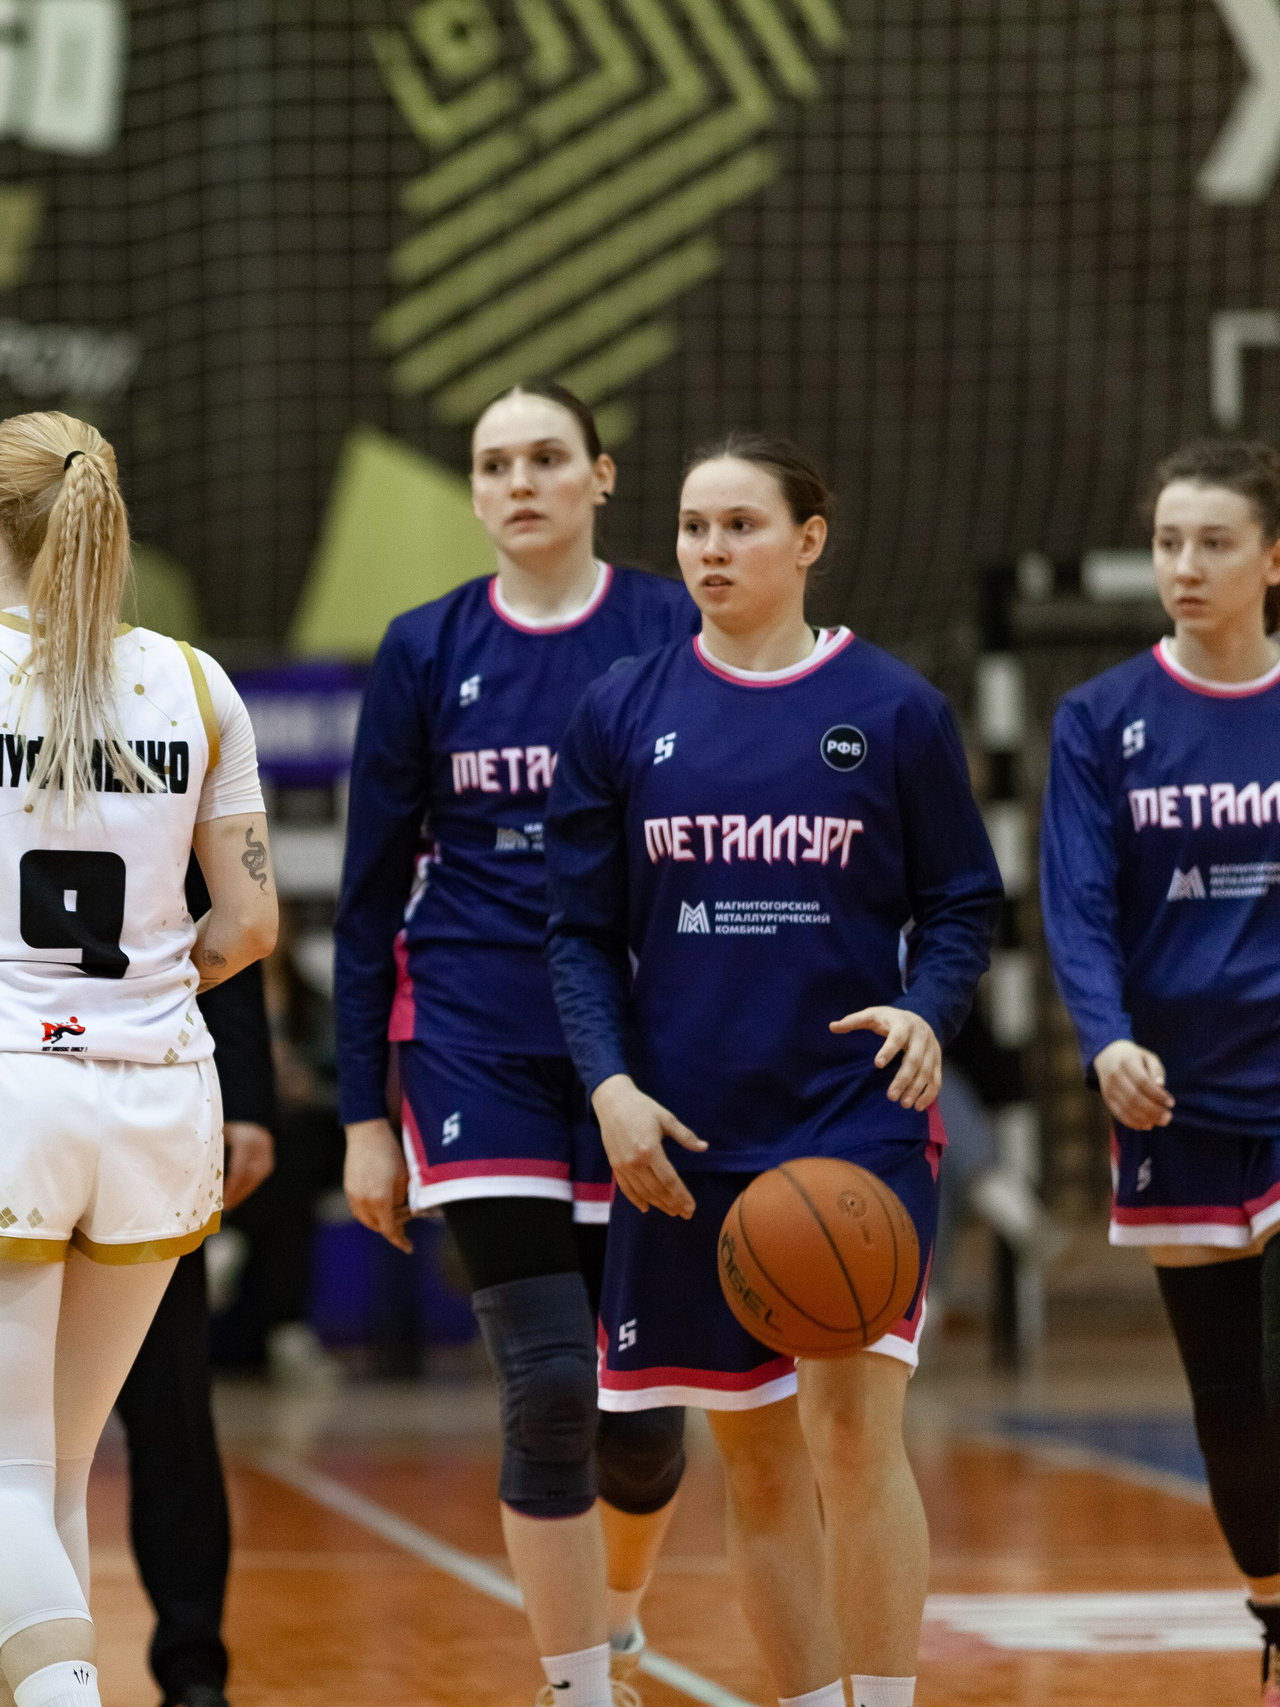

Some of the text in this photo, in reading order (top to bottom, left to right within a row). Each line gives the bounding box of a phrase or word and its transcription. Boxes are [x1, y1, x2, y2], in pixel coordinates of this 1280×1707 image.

[827, 739, 861, 756] РФБ
[451, 744, 558, 796] МЕТА
[644, 814, 864, 870] МЕТАЛЛУРГ
[714, 900, 820, 911] МАГНИТОГОРСКИЙ
[19, 849, 130, 980] 9
[714, 912, 831, 924] МЕТАЛЛУРГИЧЕСКИЙ
[714, 925, 778, 935] КОМБИНАТ
